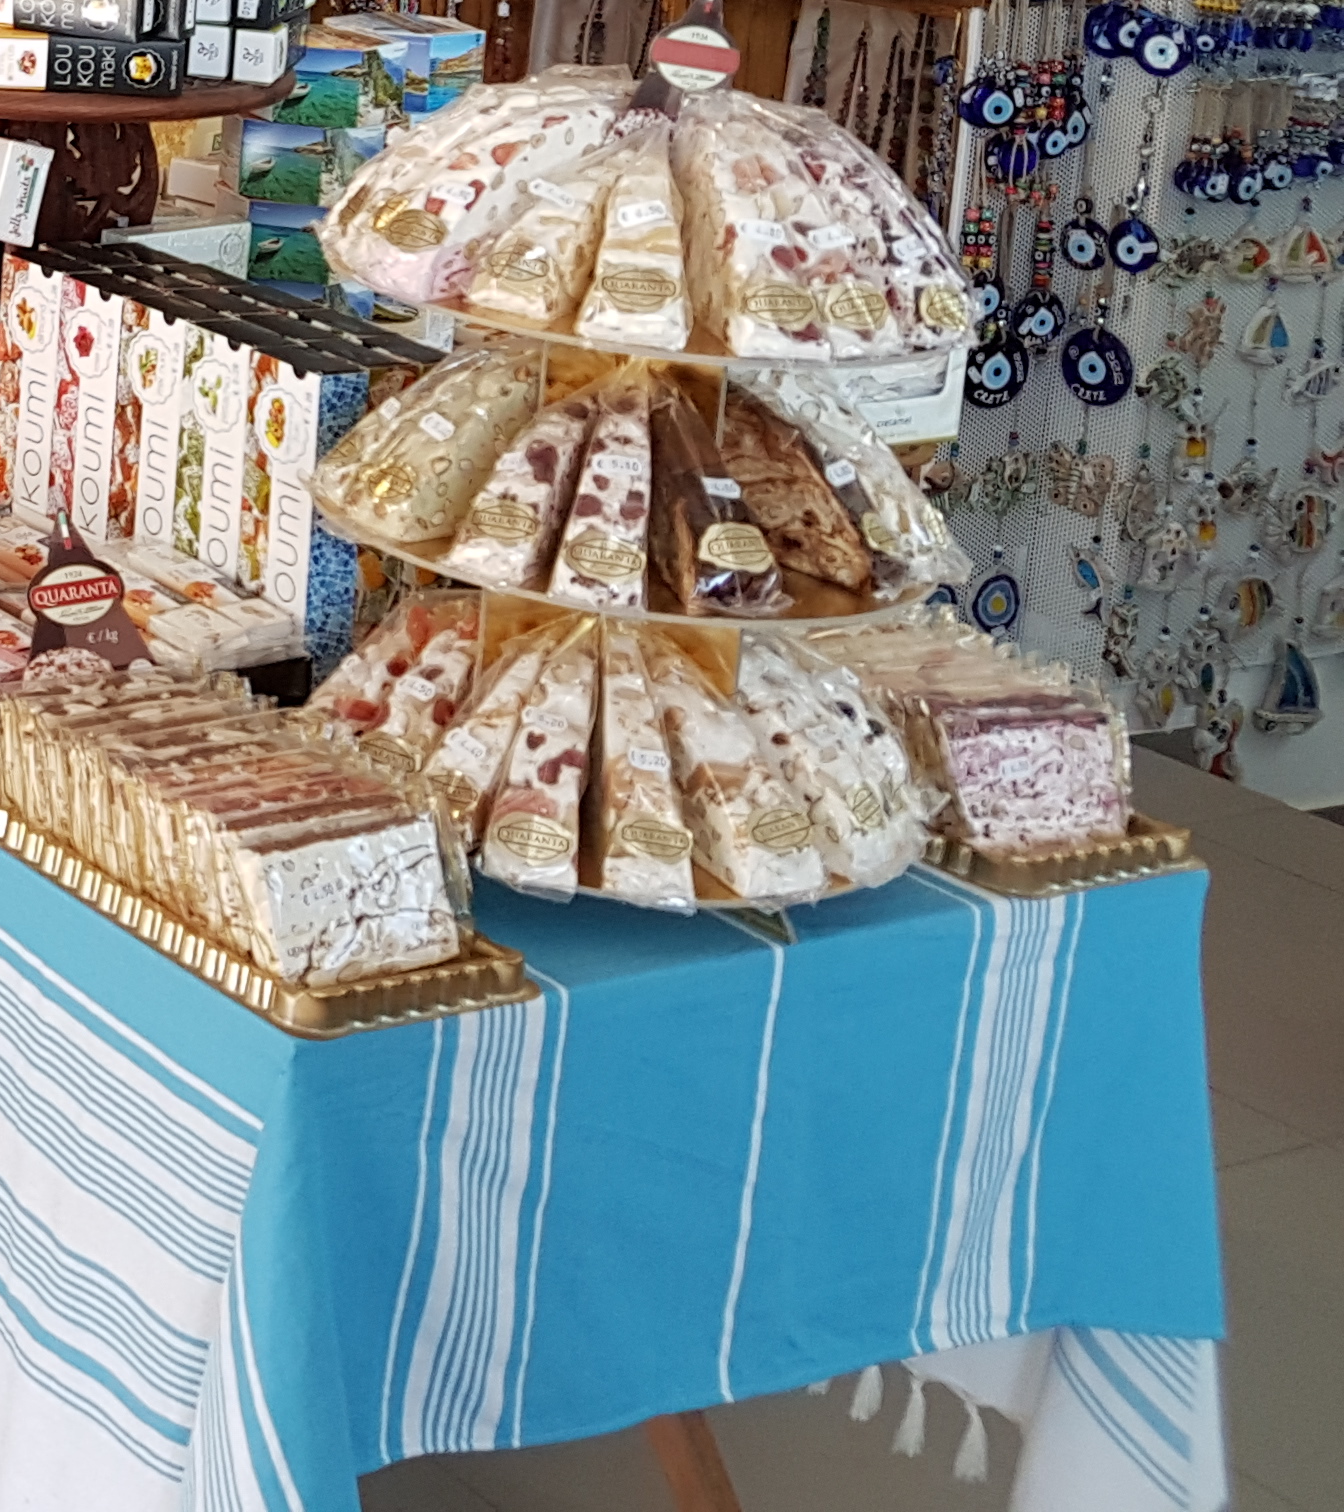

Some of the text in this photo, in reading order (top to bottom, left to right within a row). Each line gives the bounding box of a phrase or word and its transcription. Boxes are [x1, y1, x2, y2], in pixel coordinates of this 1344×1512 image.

[54, 44, 73, 87] LOU
[76, 45, 96, 88] KOU
[973, 389, 1011, 404] CRETE
[1070, 383, 1107, 402] CRETE
[574, 547, 639, 567] QUARANTA
[33, 576, 118, 609] QUARANTA
[501, 829, 564, 848] QUARANTA
